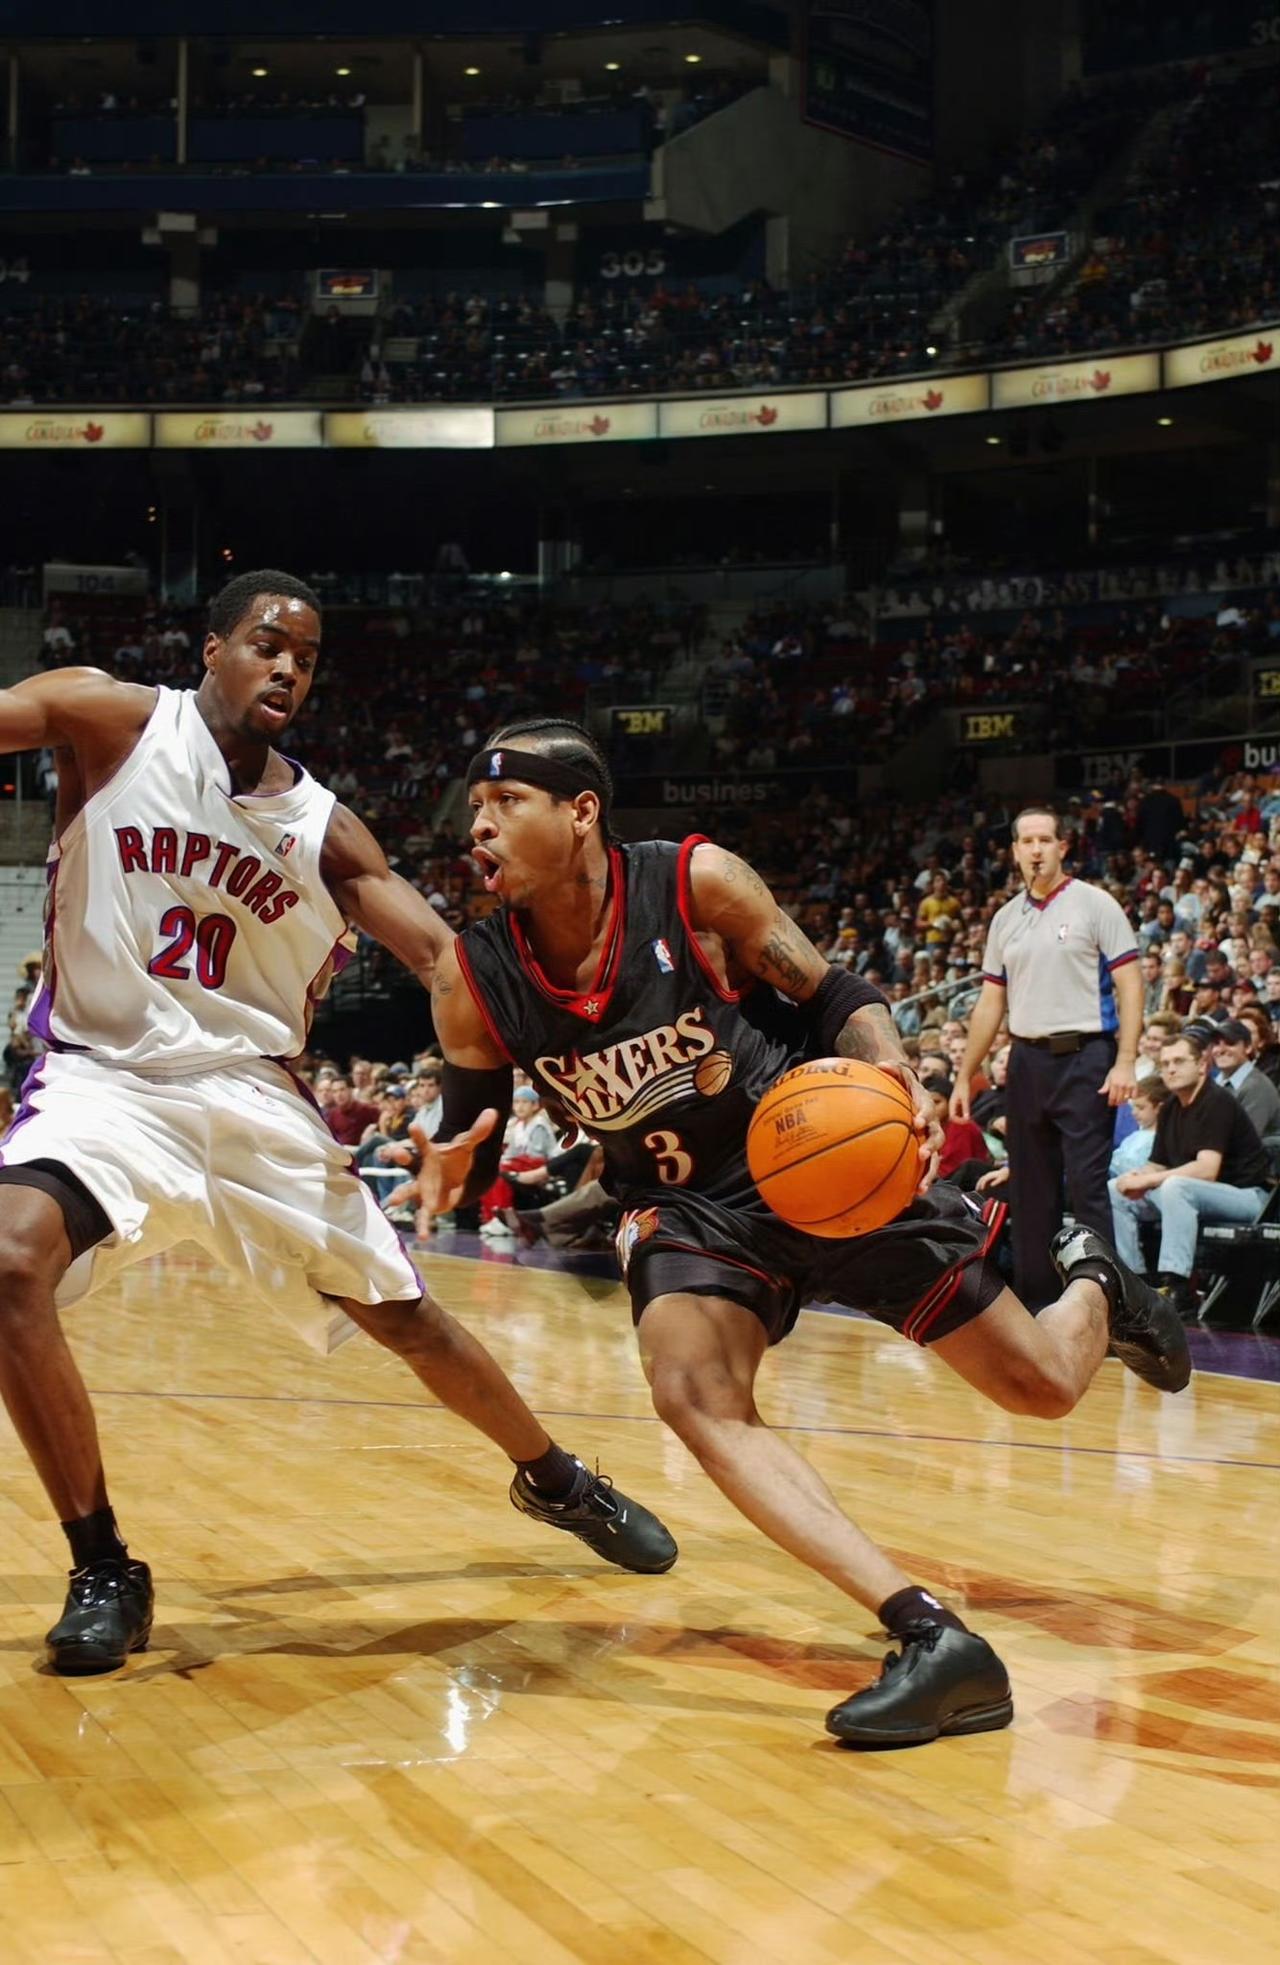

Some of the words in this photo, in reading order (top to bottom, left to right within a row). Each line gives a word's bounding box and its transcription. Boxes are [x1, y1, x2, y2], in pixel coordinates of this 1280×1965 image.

[600, 250, 666, 278] 305
[77, 574, 114, 593] 104
[616, 710, 667, 734] IBM
[966, 713, 1015, 740] IBM
[114, 826, 299, 924] RAPTORS
[147, 905, 237, 990] 20
[775, 1109, 807, 1135] NBA
[644, 1130, 693, 1185] 3
